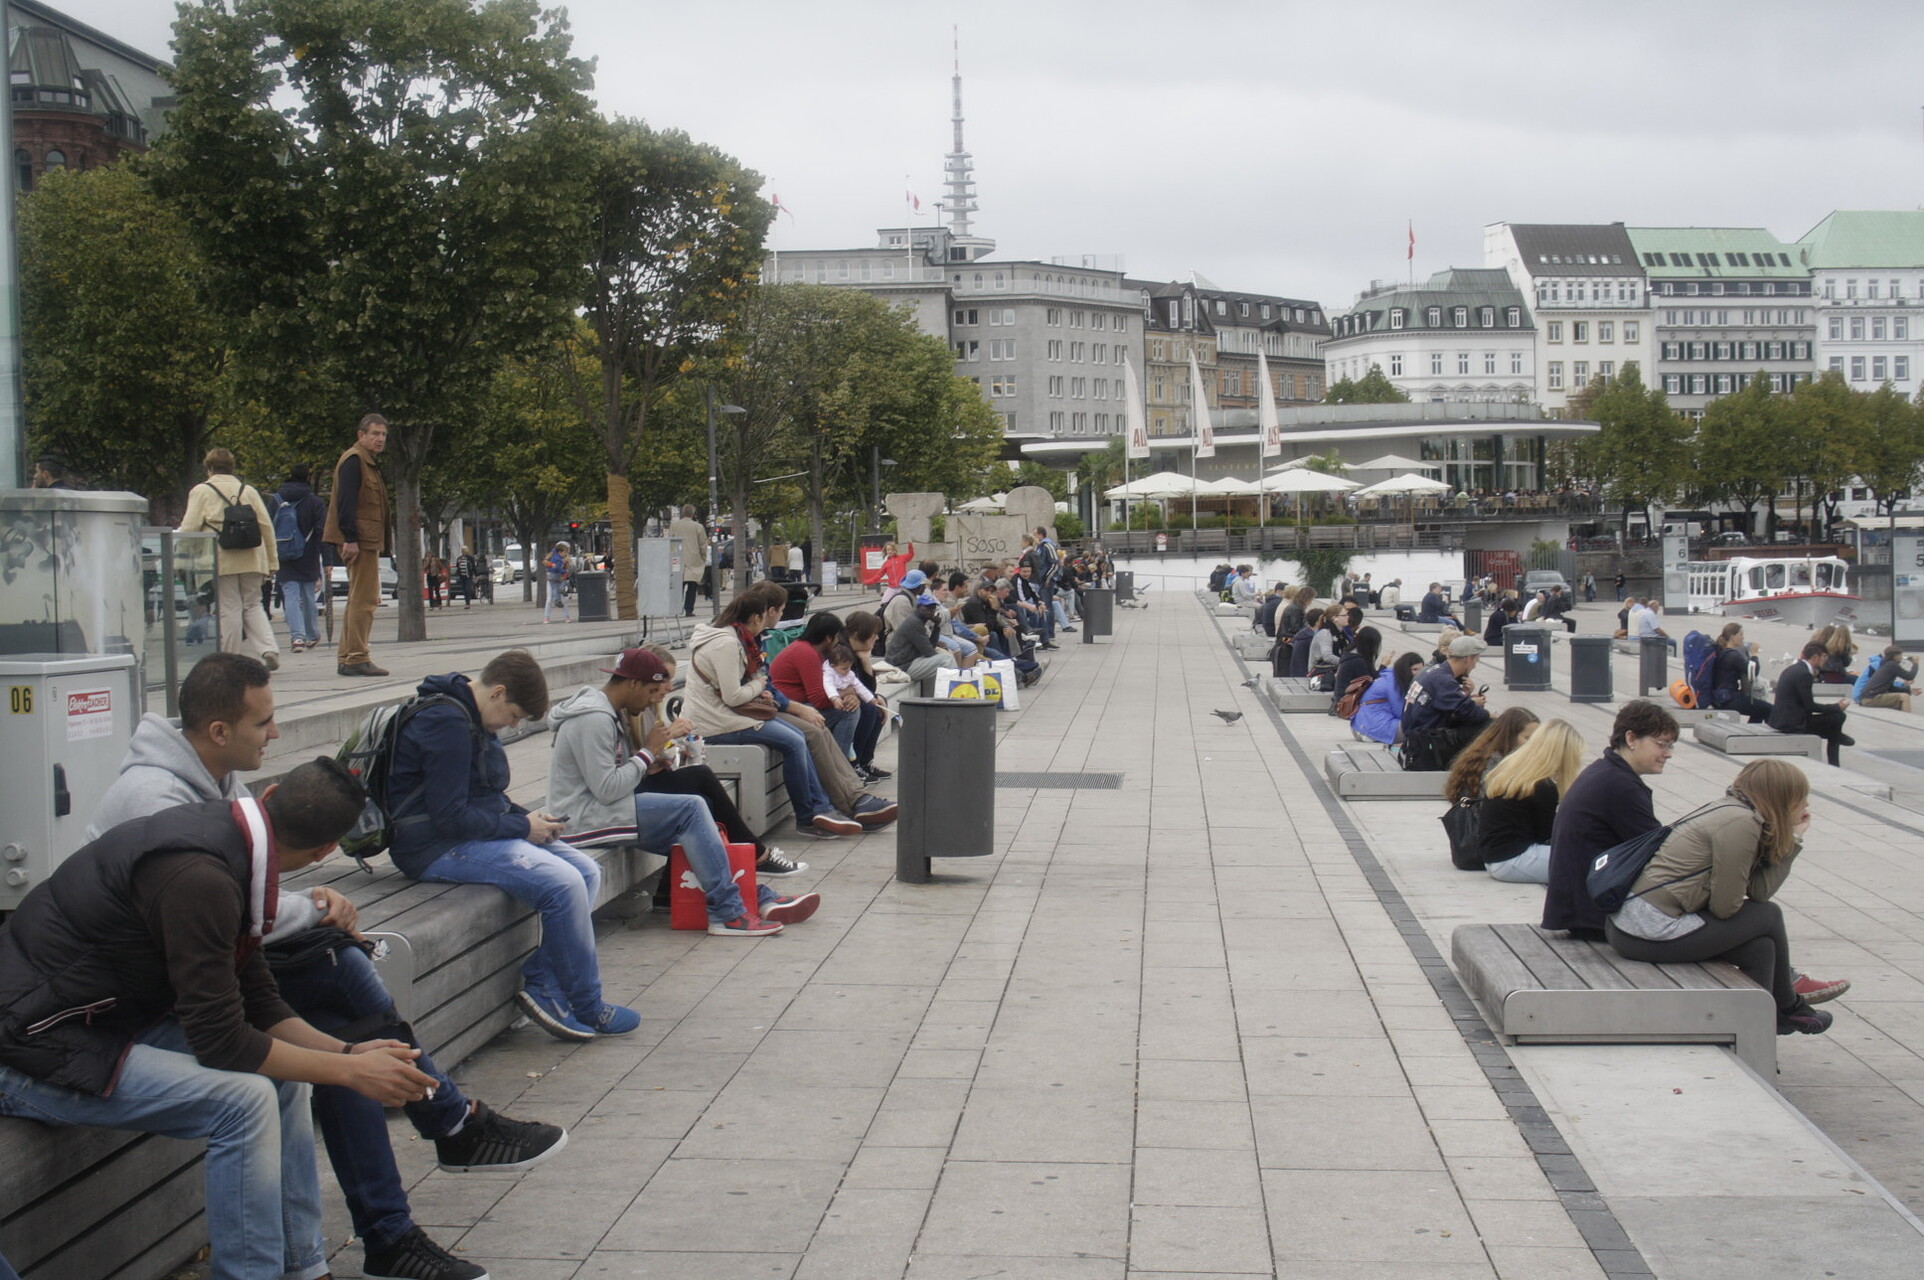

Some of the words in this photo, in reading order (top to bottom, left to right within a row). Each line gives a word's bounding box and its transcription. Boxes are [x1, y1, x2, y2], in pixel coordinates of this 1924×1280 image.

[1678, 548, 1686, 558] 6
[1916, 554, 1924, 567] 5
[984, 688, 999, 696] DL
[11, 687, 31, 713] 06
